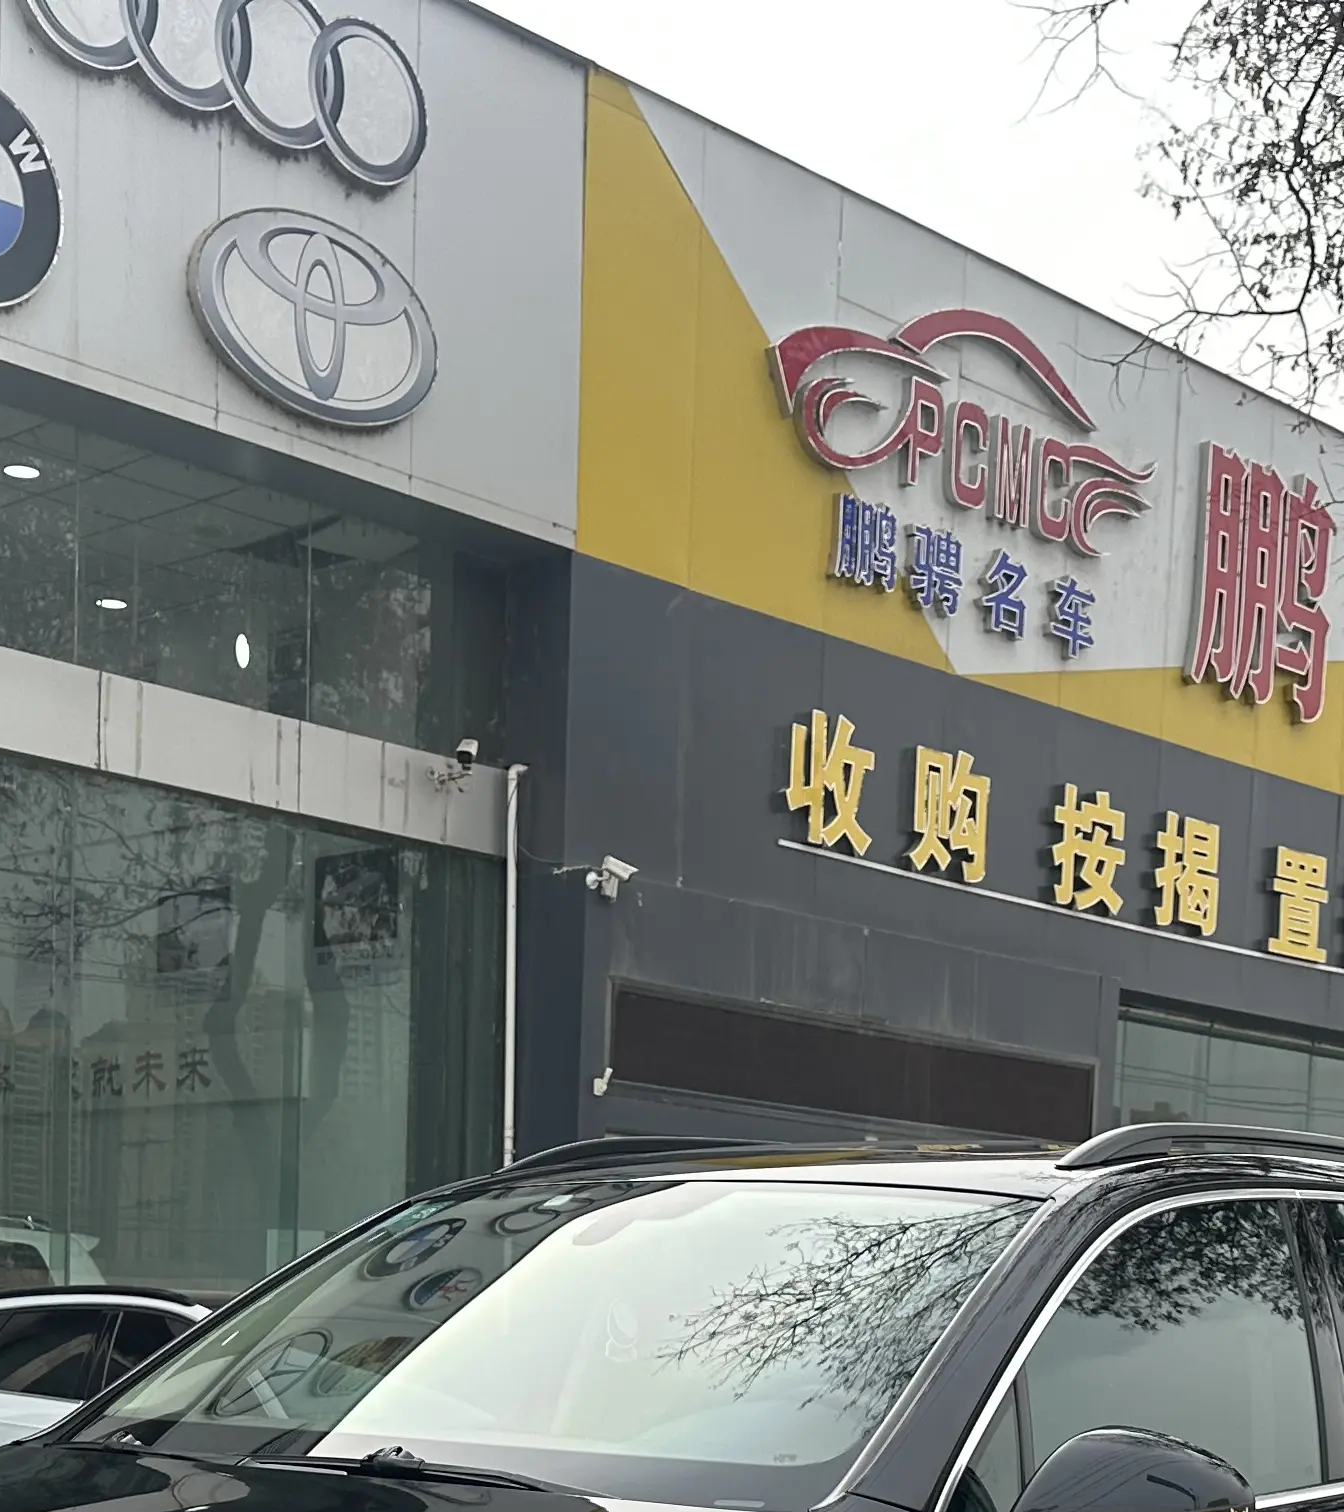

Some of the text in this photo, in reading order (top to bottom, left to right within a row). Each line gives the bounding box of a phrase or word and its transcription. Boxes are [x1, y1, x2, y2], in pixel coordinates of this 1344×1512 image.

[834, 493, 1096, 659] 鹏骋名车
[786, 708, 990, 883] 收购
[1052, 783, 1220, 936] 按揭
